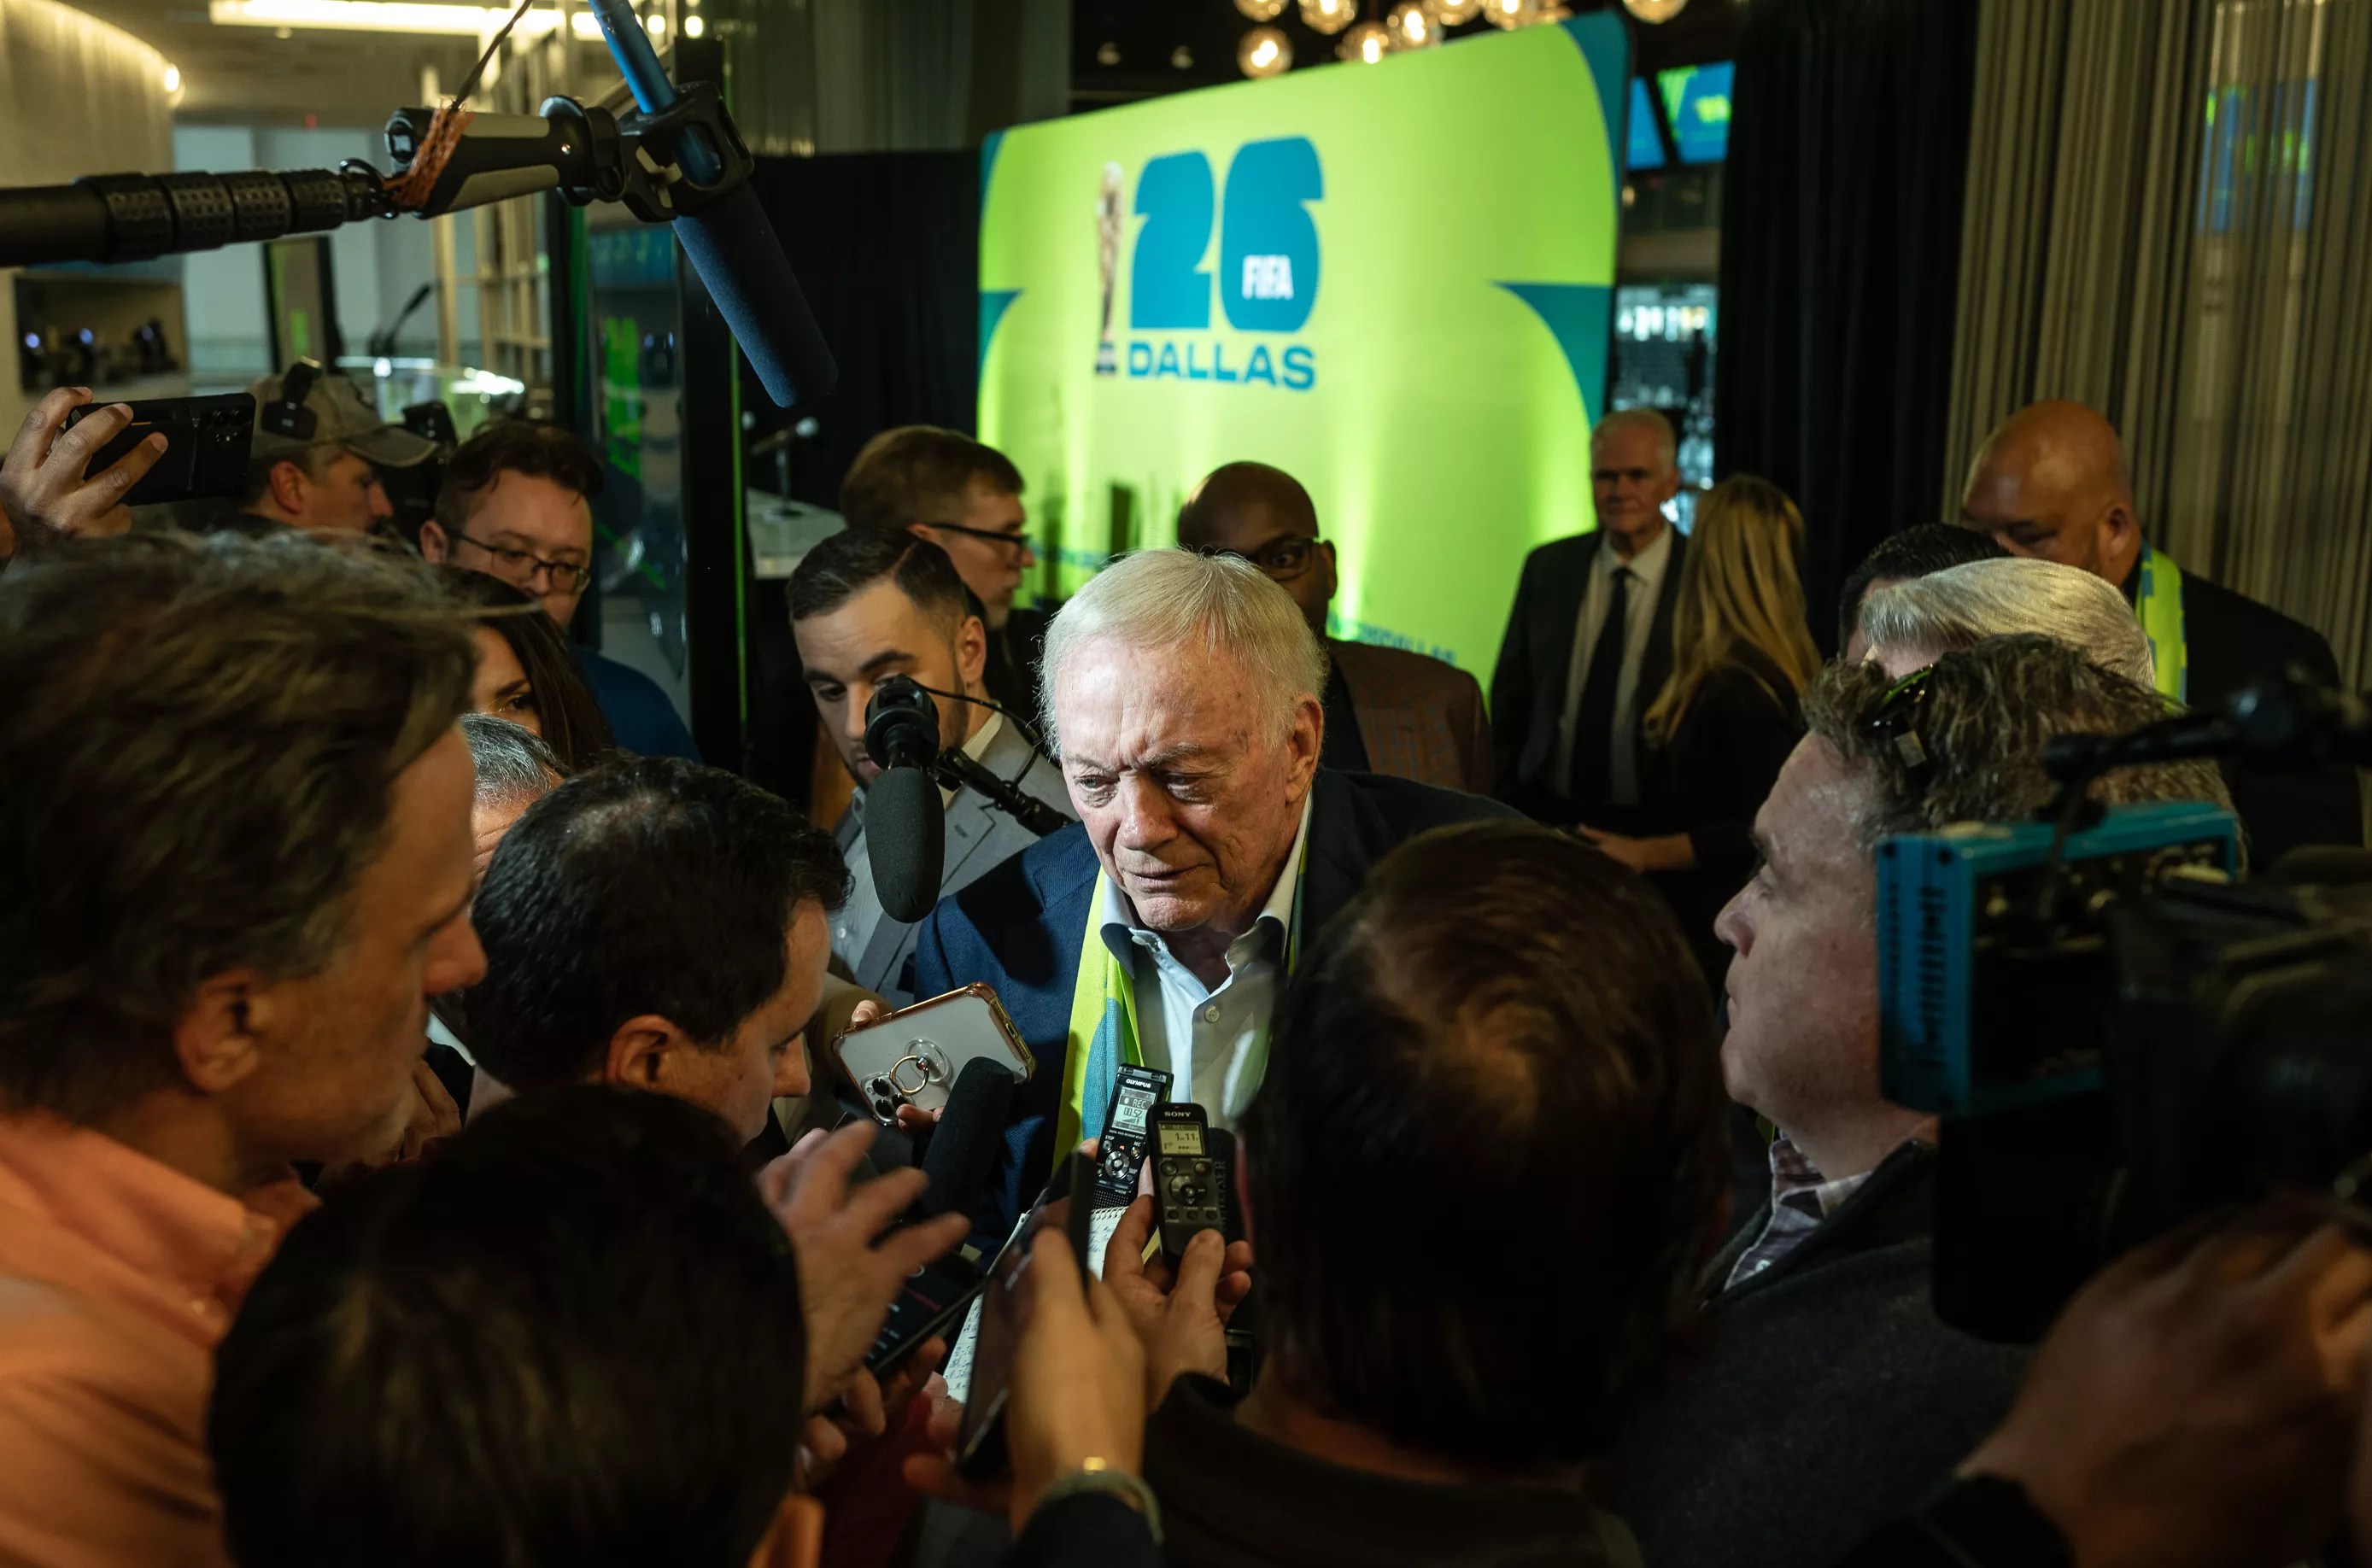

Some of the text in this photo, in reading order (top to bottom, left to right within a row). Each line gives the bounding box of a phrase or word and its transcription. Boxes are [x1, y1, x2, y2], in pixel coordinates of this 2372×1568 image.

[1130, 135, 1325, 333] 26
[1242, 255, 1294, 299] FIFA
[1127, 341, 1315, 391] DALLAS
[1126, 1079, 1151, 1088] OLYMPUS
[1133, 1098, 1146, 1109] REC
